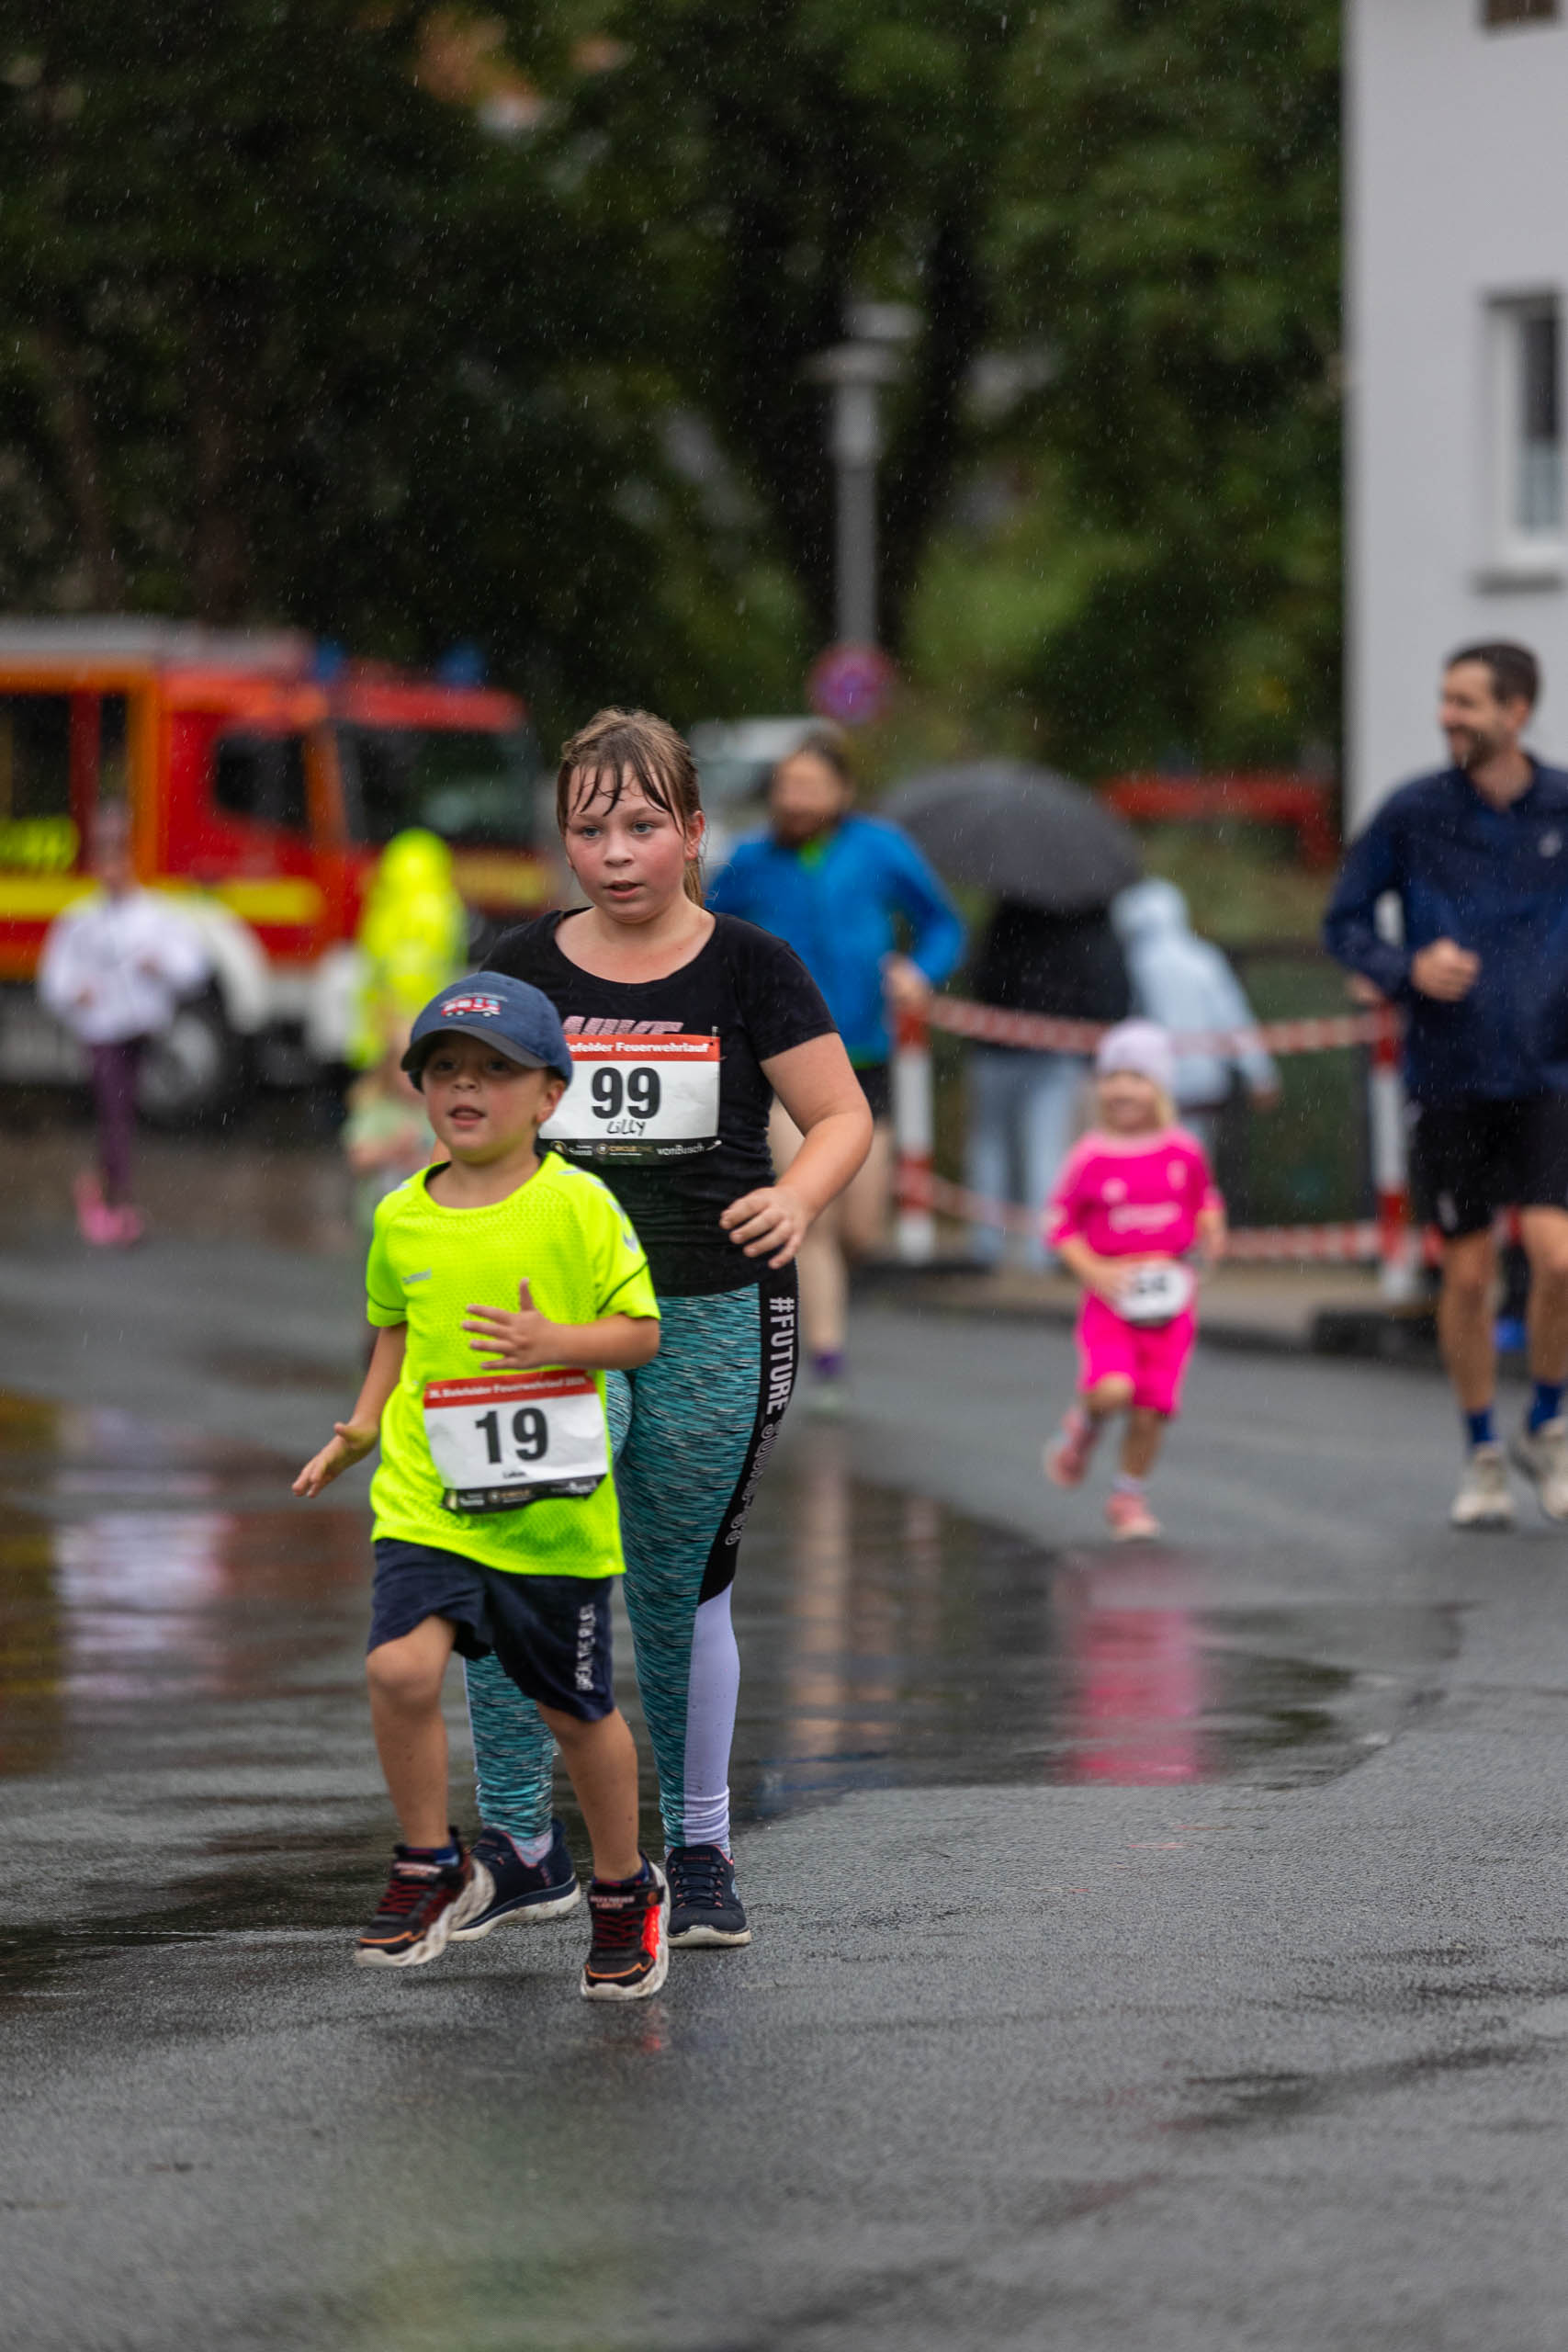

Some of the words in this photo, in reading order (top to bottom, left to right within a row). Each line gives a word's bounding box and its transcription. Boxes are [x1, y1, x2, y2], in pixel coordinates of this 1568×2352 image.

[615, 1042, 709, 1053] Feuerwehrlauf
[591, 1067, 661, 1119] 99
[766, 1296, 795, 1416] #FUTURE
[474, 1408, 548, 1465] 19
